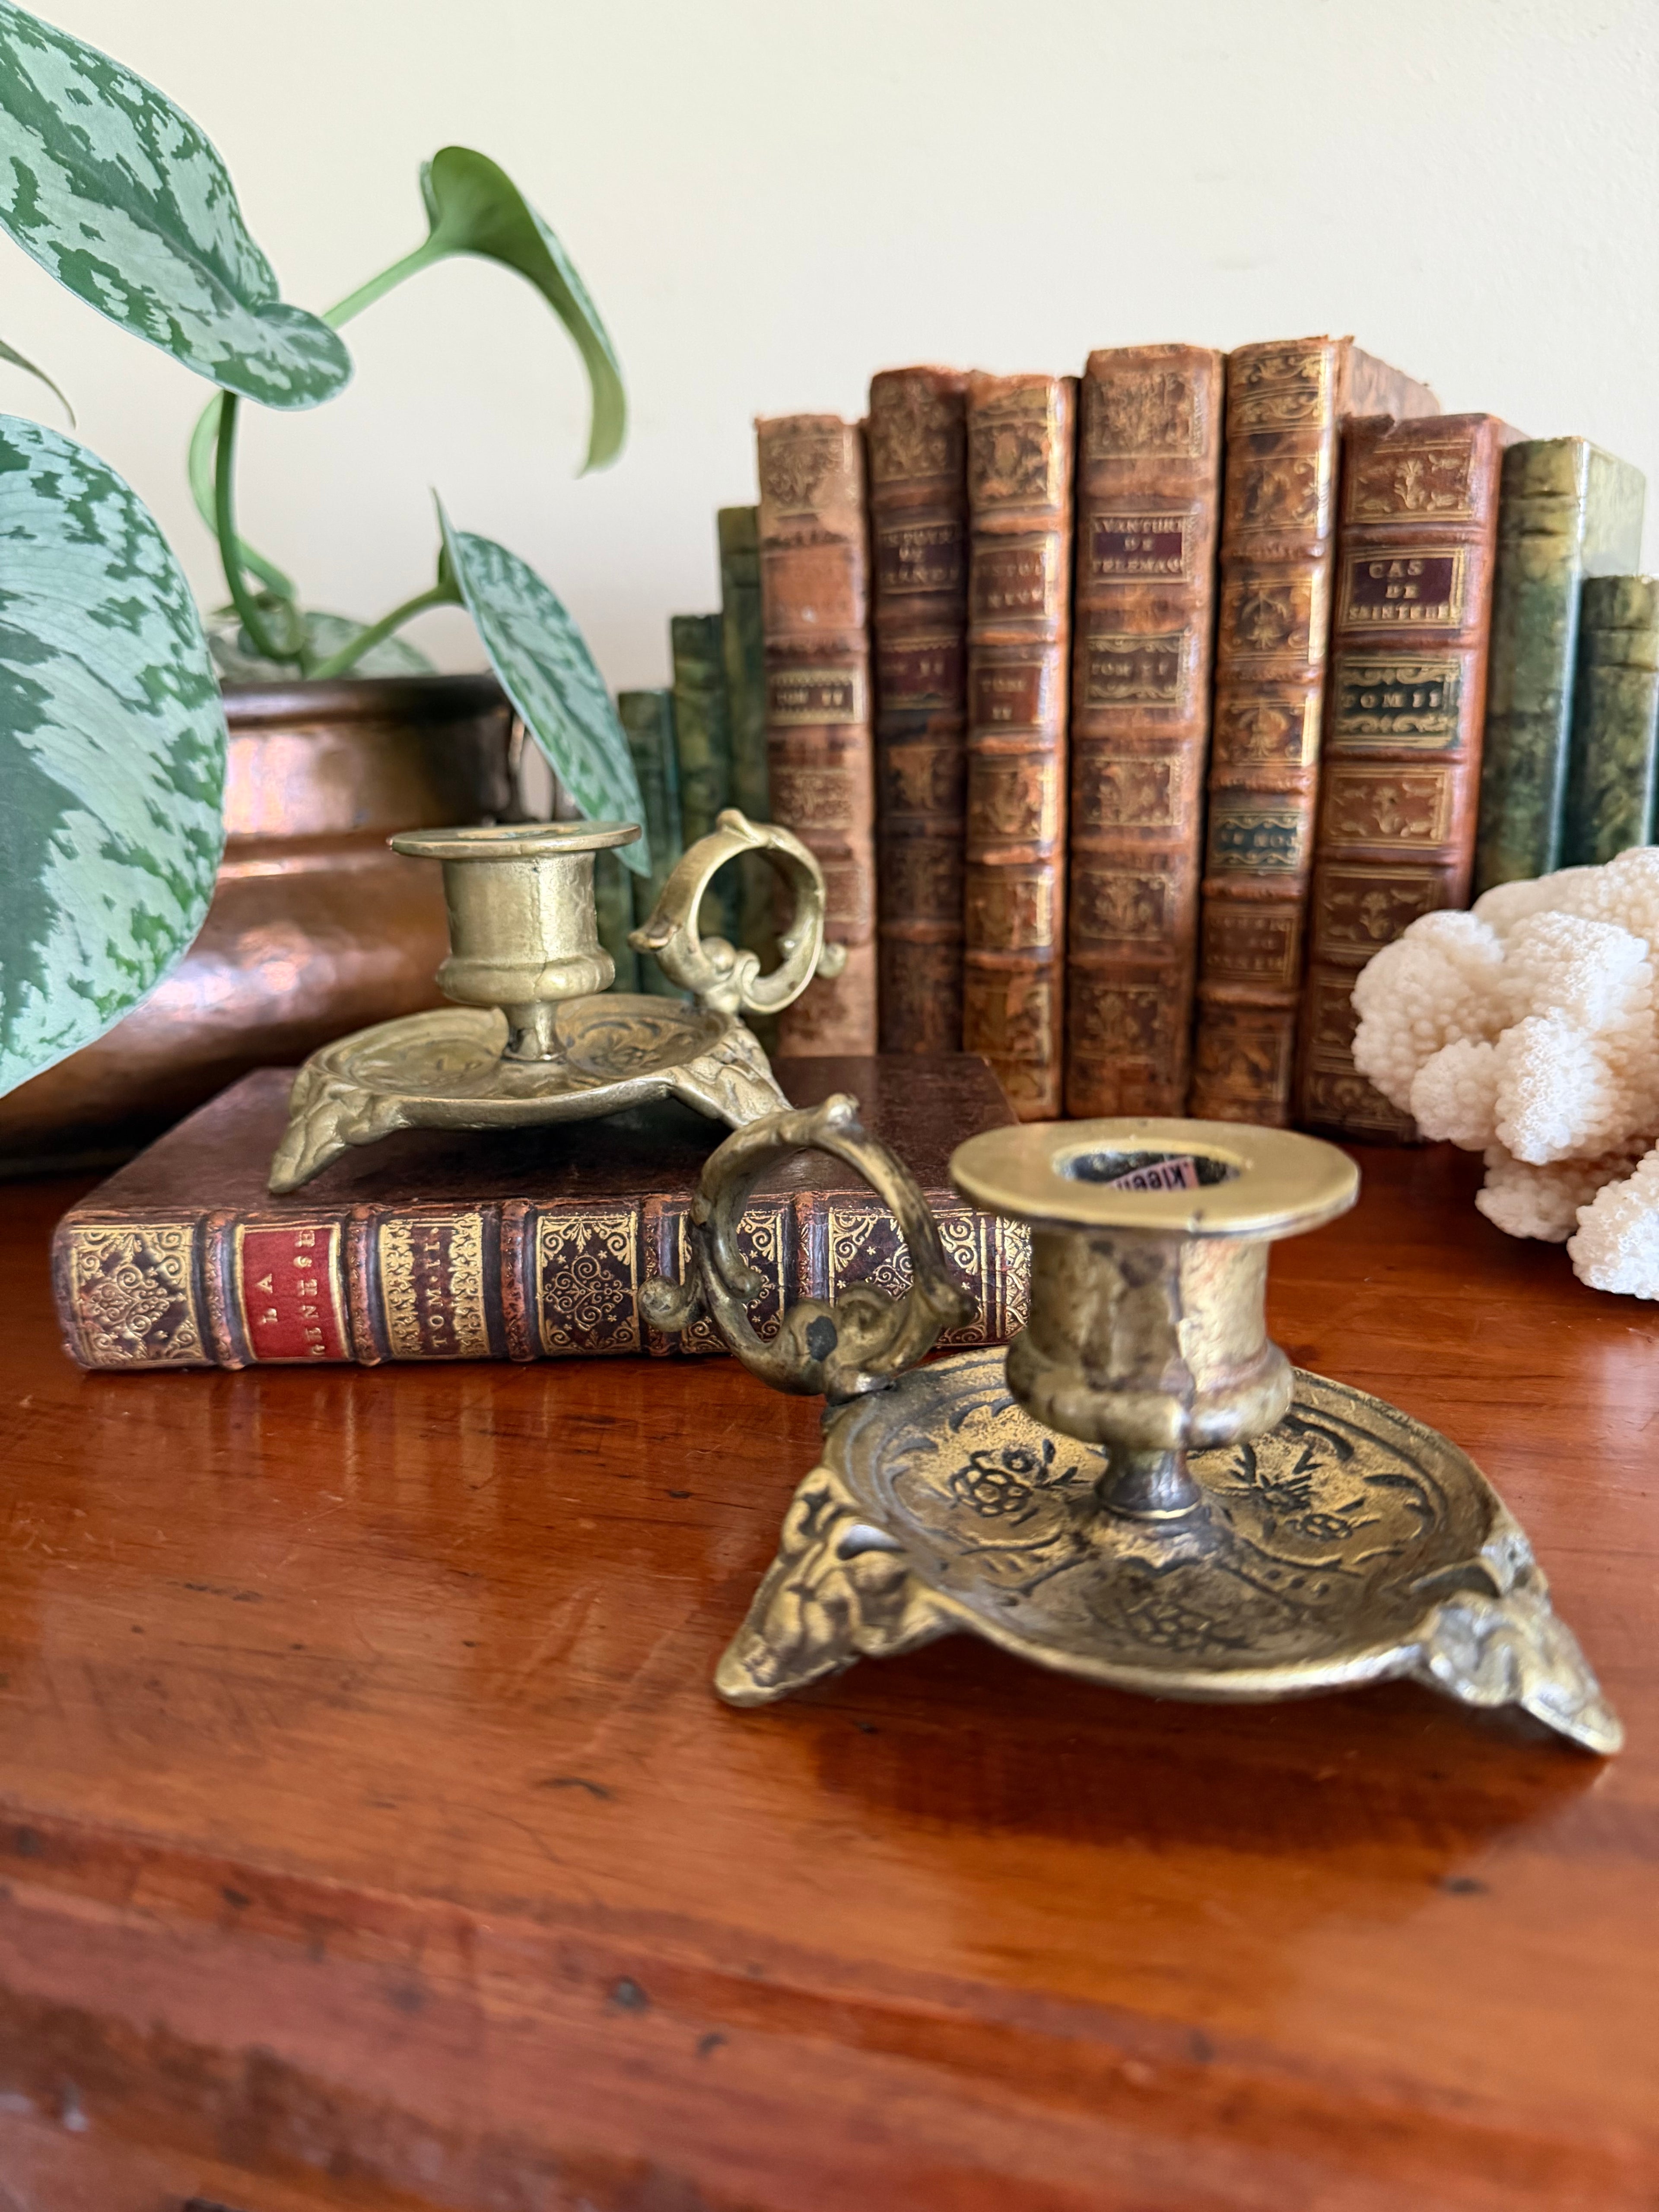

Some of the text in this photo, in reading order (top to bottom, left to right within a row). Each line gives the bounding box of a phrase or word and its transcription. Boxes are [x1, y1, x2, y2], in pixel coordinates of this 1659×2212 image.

[1369, 559, 1424, 579] CAS
[255, 1273, 278, 1324] LA
[294, 1230, 325, 1356] GENESE
